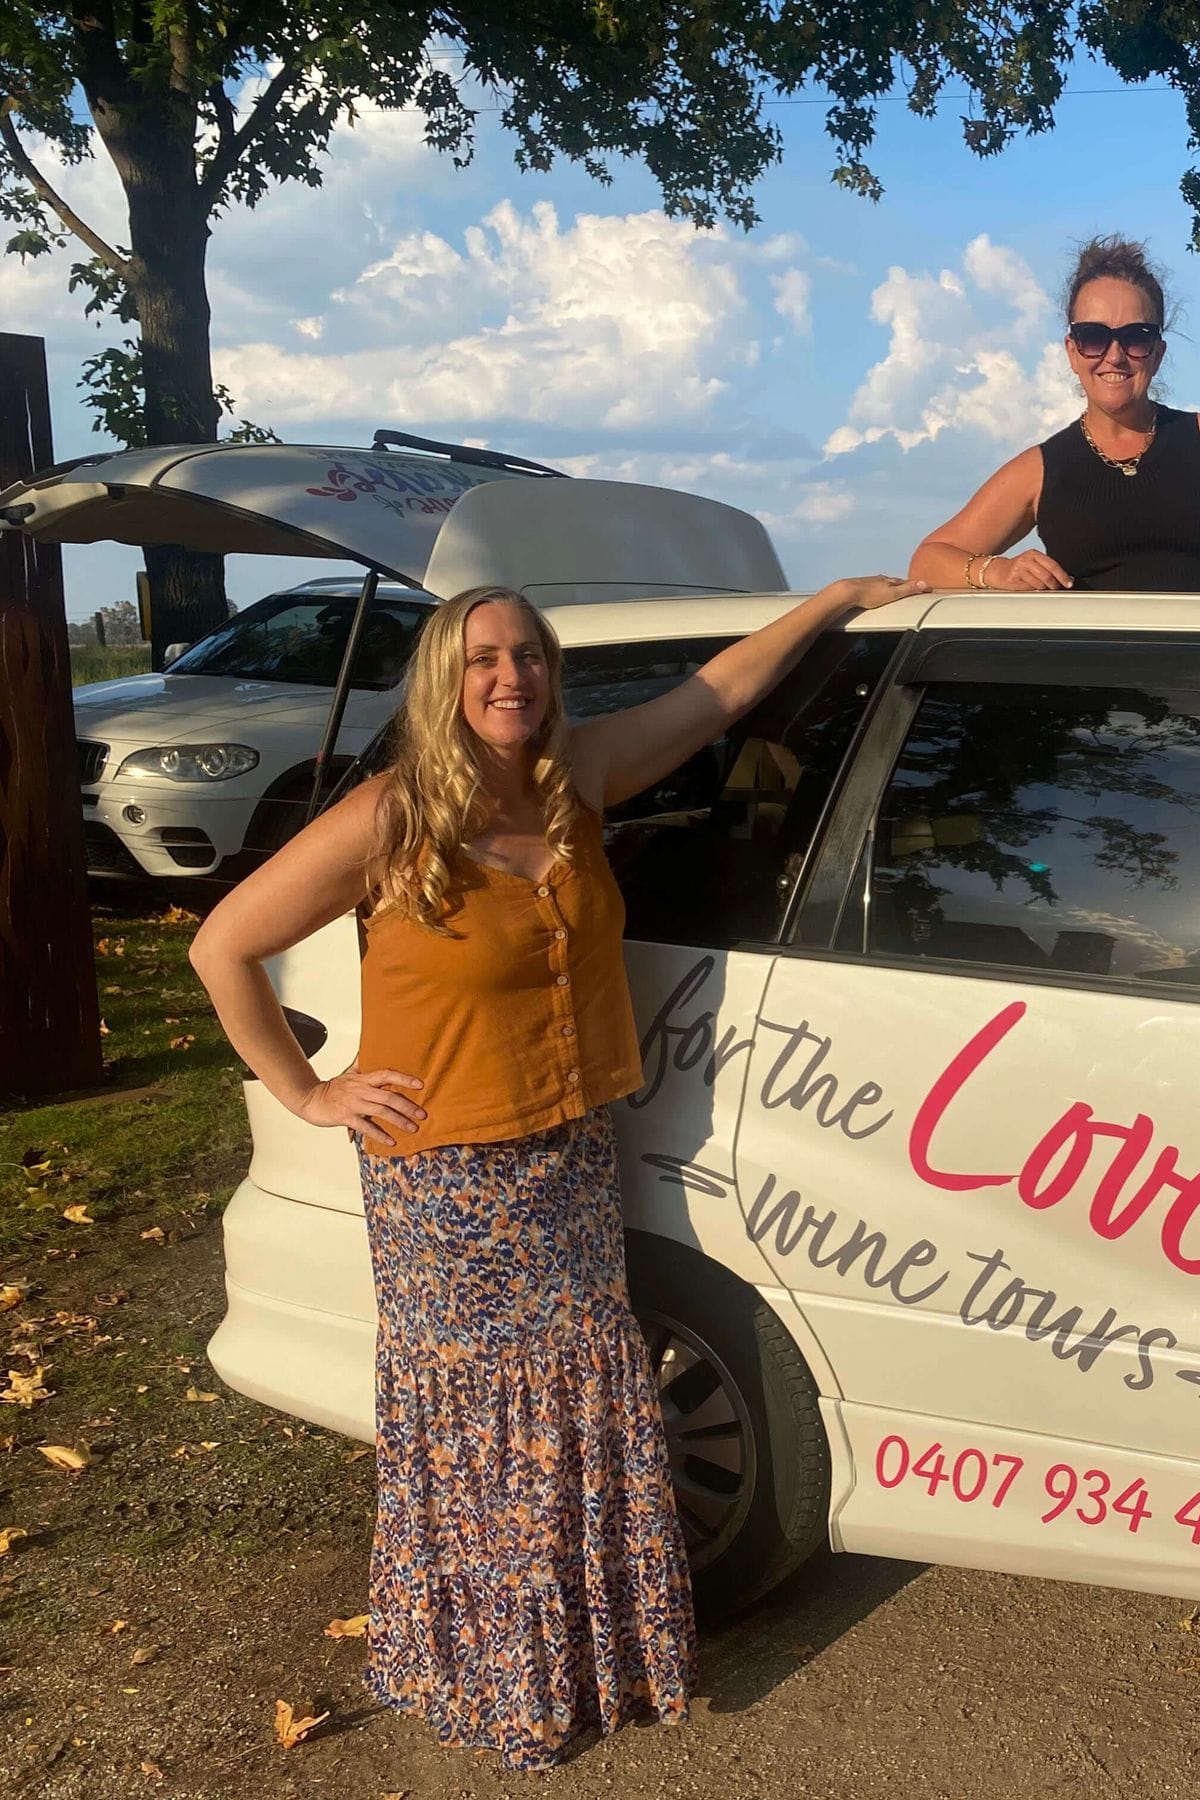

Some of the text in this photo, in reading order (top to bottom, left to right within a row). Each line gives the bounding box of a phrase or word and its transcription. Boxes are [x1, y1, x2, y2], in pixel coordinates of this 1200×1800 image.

[627, 955, 756, 1109] for
[755, 1019, 894, 1140] the
[747, 1174, 1178, 1392] wine tours
[875, 1434, 1024, 1509] 0407
[1040, 1463, 1153, 1534] 934
